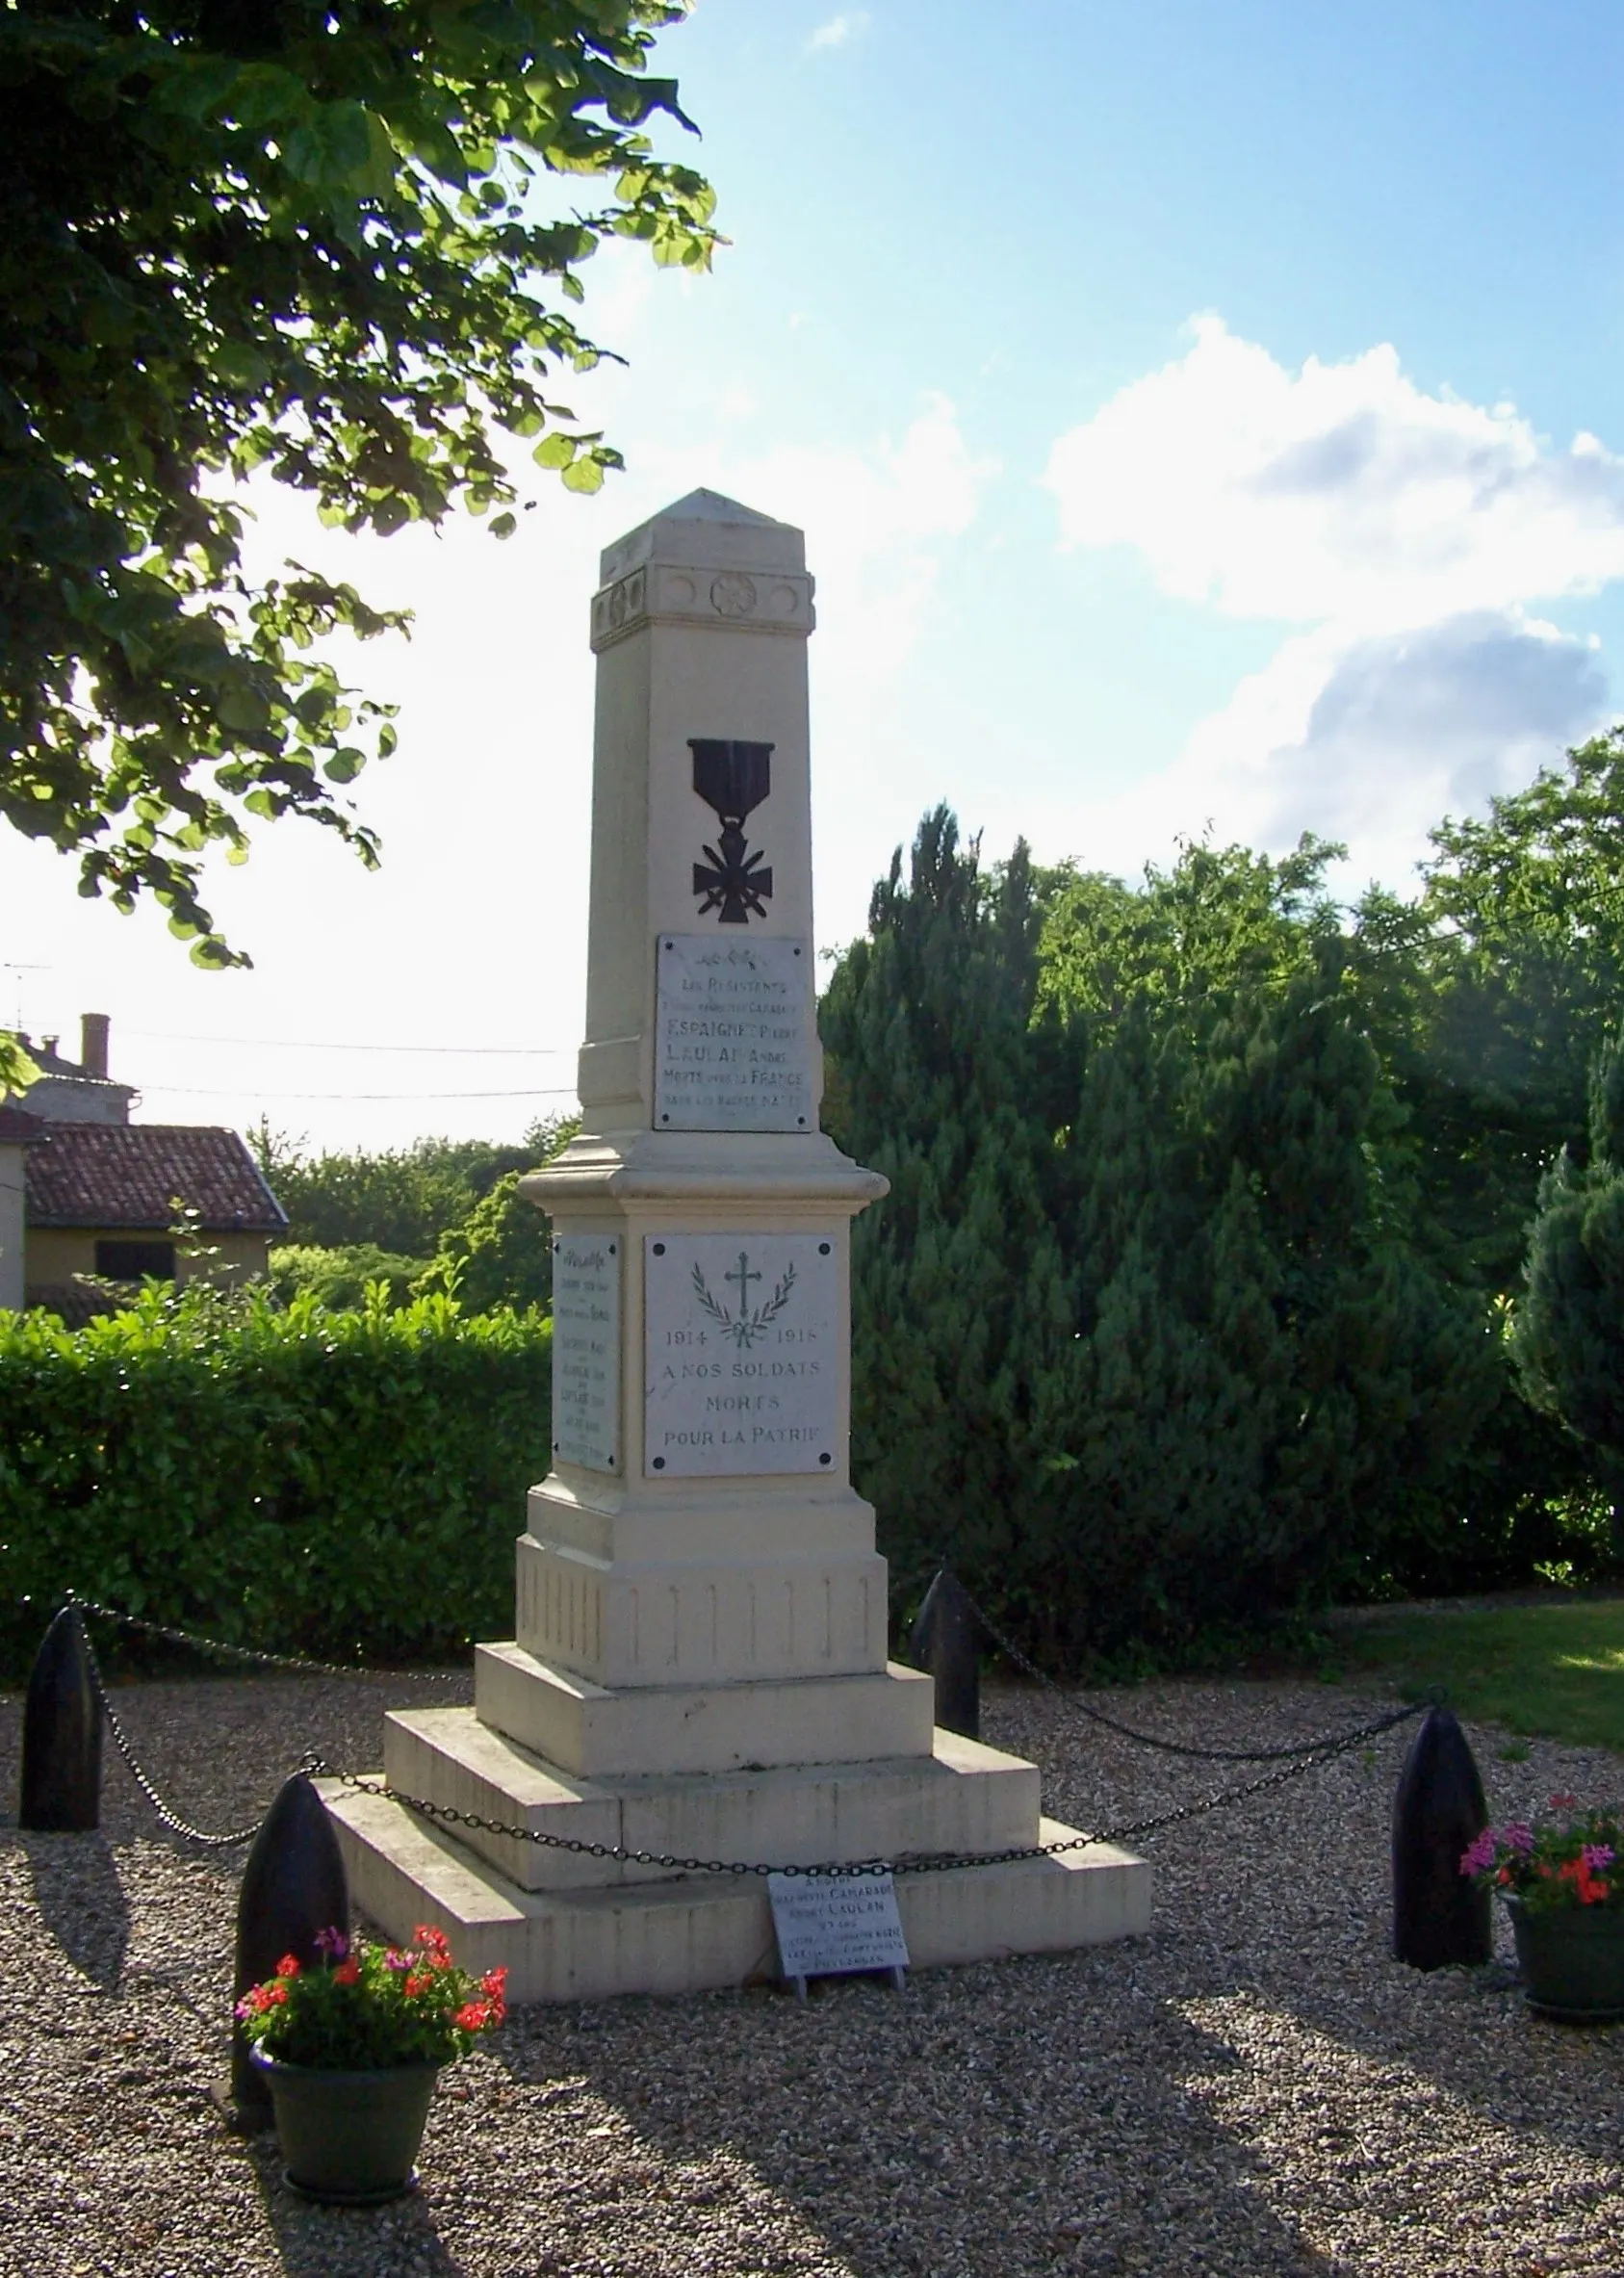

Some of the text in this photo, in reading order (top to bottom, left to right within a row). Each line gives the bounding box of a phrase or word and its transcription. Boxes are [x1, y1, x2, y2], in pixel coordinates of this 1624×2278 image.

[665, 1331, 709, 1346] 1914
[662, 1361, 821, 1380] A NOS SOLDATS
[706, 1395, 781, 1411] MORTS
[664, 1426, 820, 1447] POUR LA PATRIE
